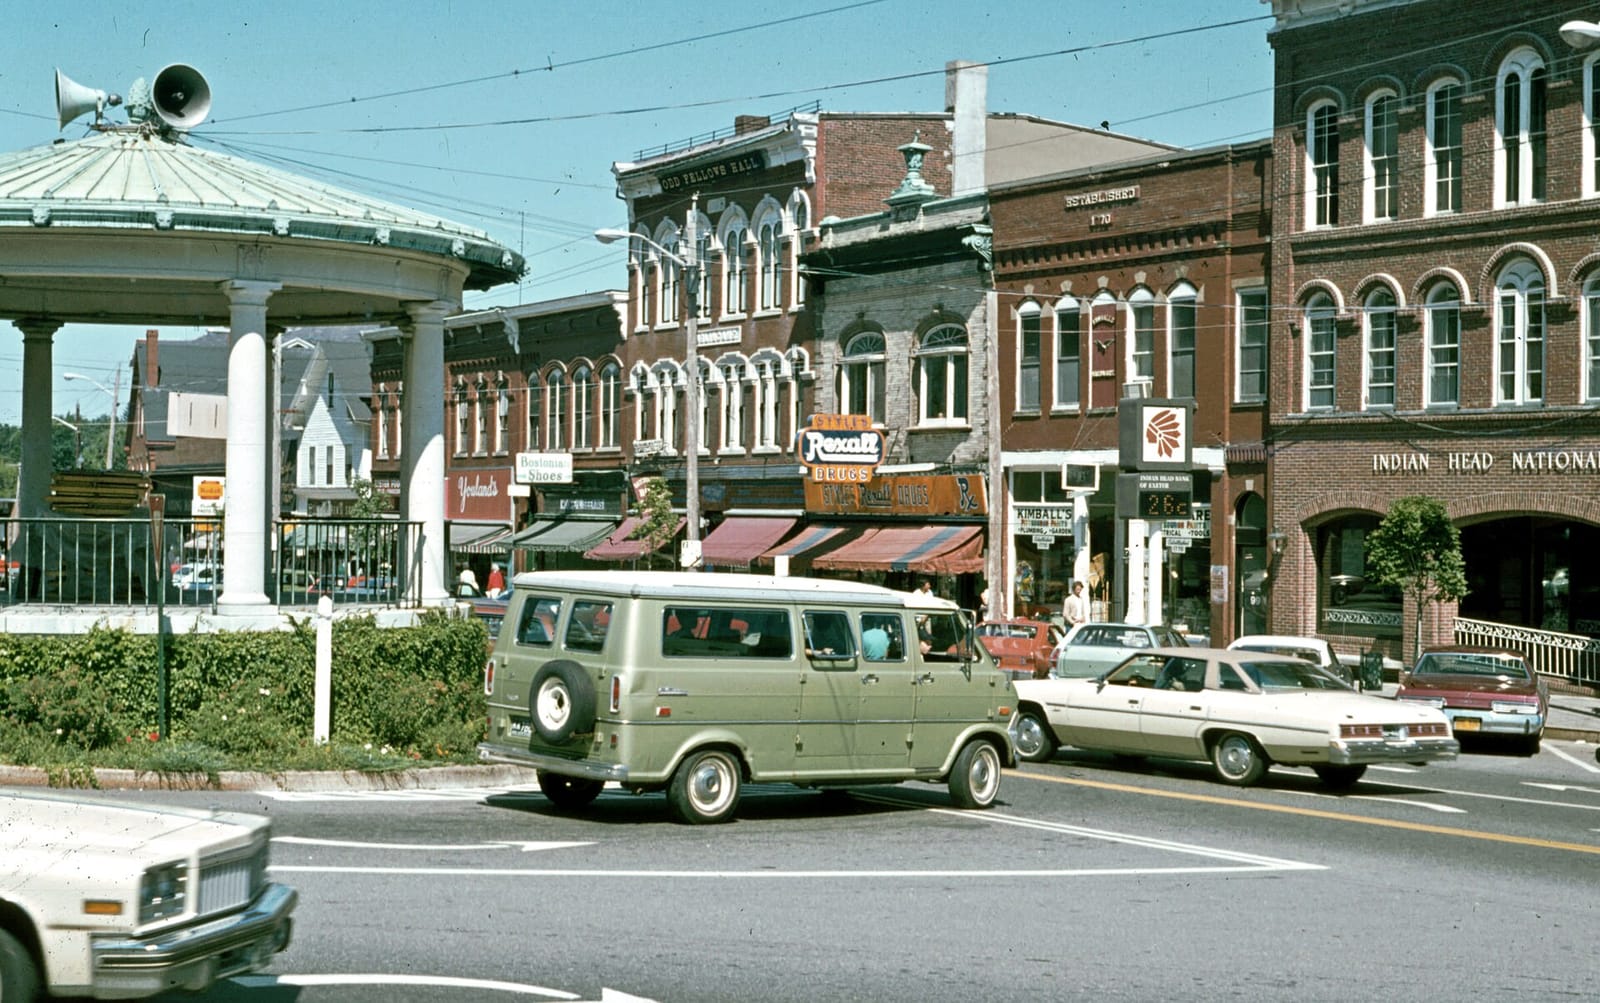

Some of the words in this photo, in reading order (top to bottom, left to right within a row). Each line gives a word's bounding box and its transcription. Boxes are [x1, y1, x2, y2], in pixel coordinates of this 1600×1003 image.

[662, 176, 681, 190] ODD
[683, 165, 727, 184] FELLOWS
[730, 158, 758, 173] HALL
[1066, 188, 1136, 208] ESTABLISHED
[804, 432, 880, 462] Rexall
[1373, 453, 1430, 470] INDIAN
[1449, 453, 1493, 470] HEAD
[1512, 451, 1600, 469] NATIONA
[528, 469, 563, 482] Shoes
[815, 467, 869, 481] DRUGS
[458, 474, 499, 513] Youland's
[897, 484, 929, 507] DRUGS
[1017, 508, 1072, 520] KIMBALL'S
